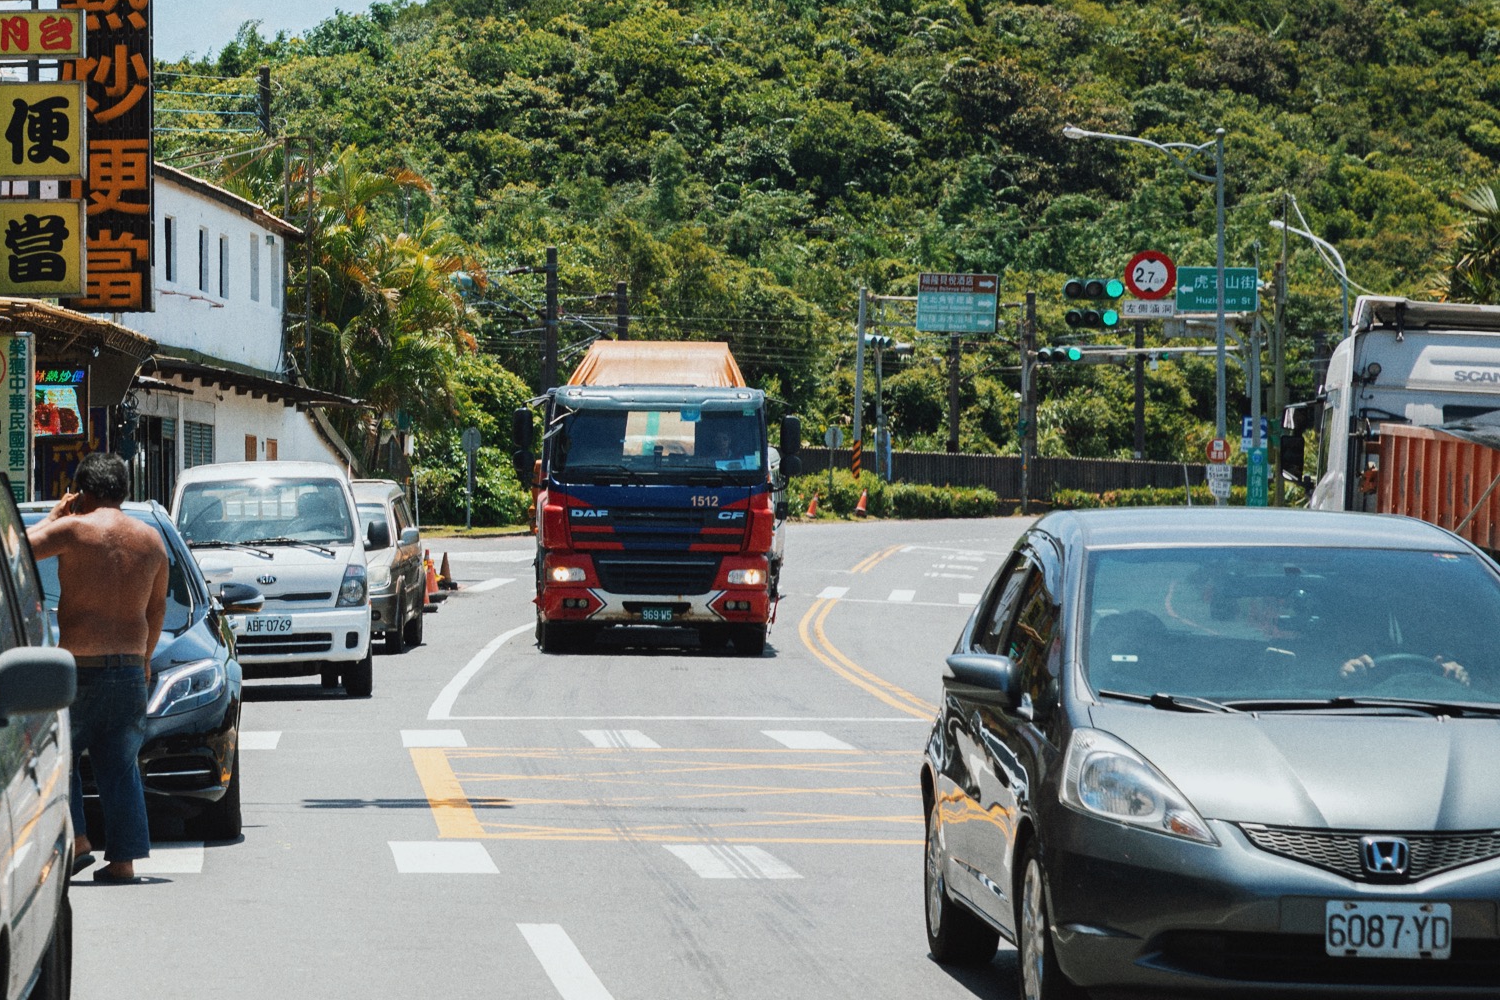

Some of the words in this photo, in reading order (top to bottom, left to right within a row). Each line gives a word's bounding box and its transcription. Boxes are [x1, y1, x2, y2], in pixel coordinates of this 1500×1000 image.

[1, 16, 73, 52] 月台
[1135, 267, 1155, 283] 2.7
[691, 496, 719, 507] 1512
[571, 509, 608, 518] DAF
[718, 512, 745, 520] CF
